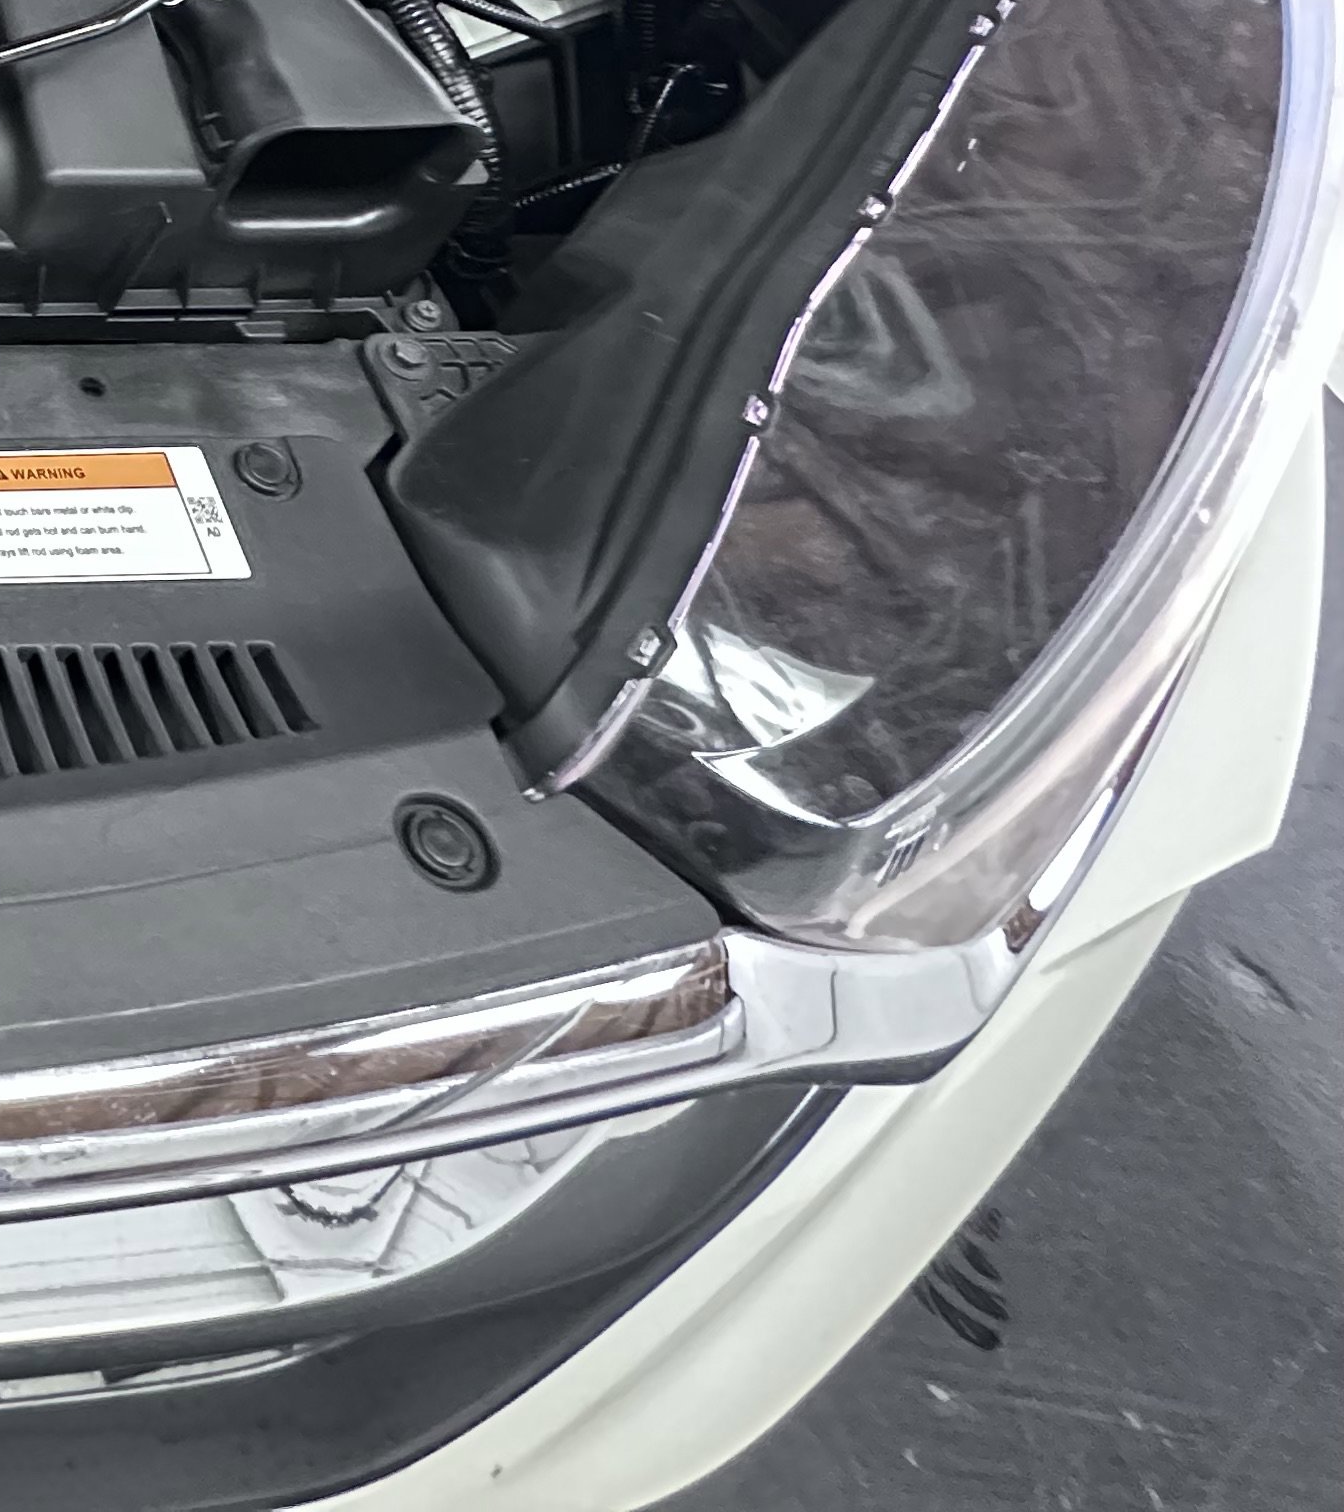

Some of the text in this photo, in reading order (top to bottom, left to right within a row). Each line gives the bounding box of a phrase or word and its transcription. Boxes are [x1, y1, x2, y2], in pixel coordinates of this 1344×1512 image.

[10, 467, 86, 481] WARNING
[3, 507, 28, 516] touch
[30, 507, 51, 516] bare
[53, 506, 78, 515] metal
[91, 506, 115, 514] white
[5, 527, 20, 536] rod
[22, 527, 42, 538] gets
[43, 526, 58, 535] hot
[60, 526, 78, 535] and
[97, 525, 119, 534] burn
[17, 547, 30, 556] lift
[31, 547, 47, 556] rod
[48, 547, 74, 558] using
[75, 546, 99, 555] foam
